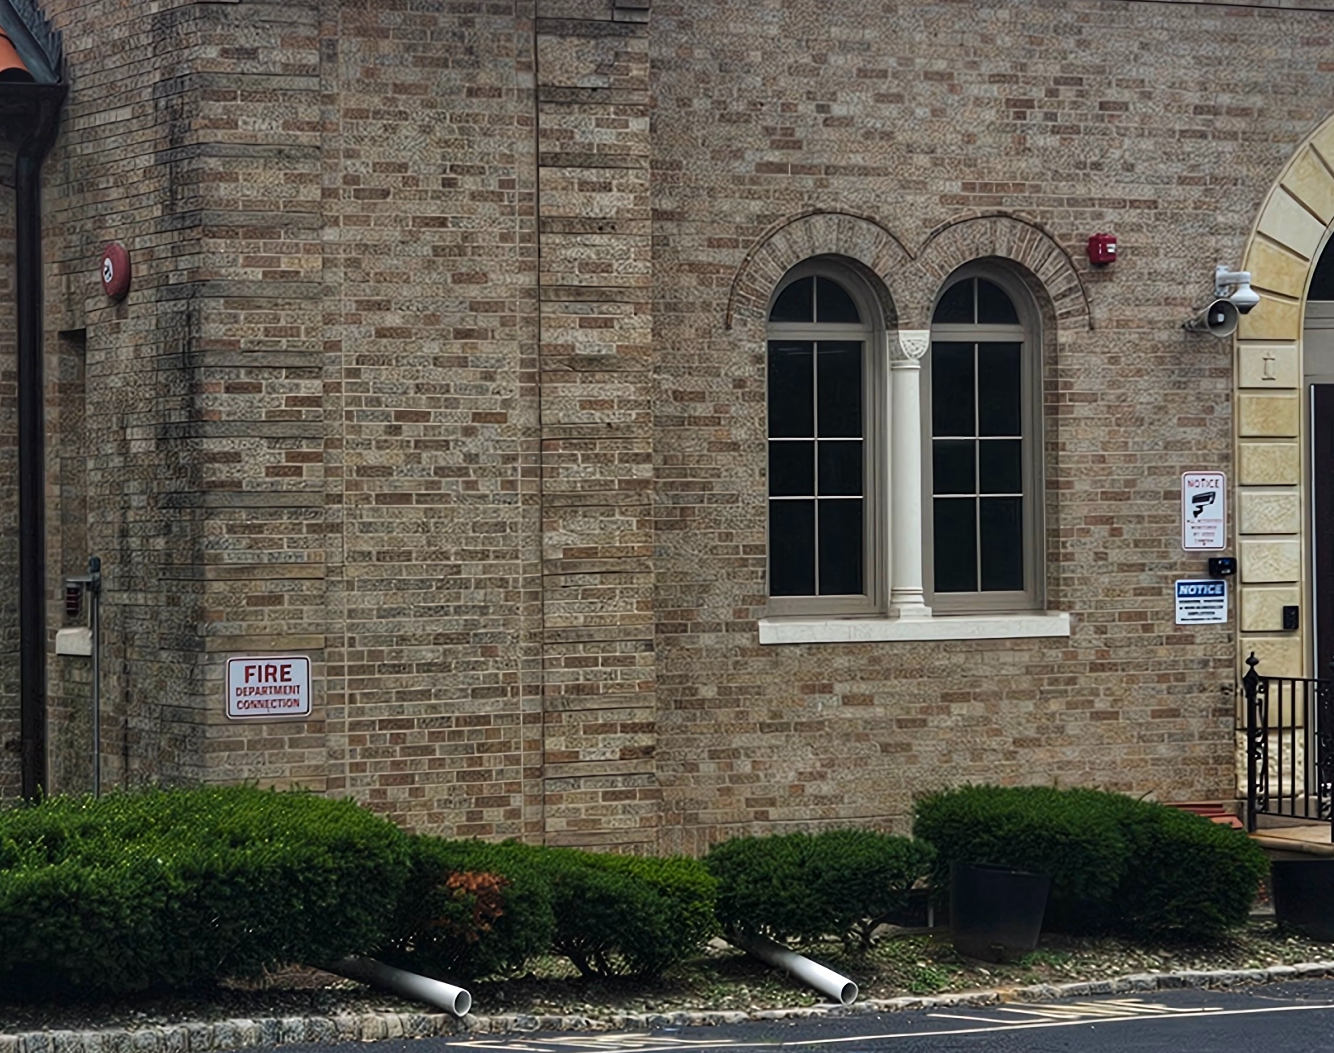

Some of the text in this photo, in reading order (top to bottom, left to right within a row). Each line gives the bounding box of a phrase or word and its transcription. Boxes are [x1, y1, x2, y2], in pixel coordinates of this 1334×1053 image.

[1187, 478, 1220, 489] NOTICE
[1179, 584, 1223, 595] NOTICE
[245, 664, 292, 684] FIRE
[236, 685, 300, 697] DEPARTMENT
[237, 699, 300, 710] CONNECTION
